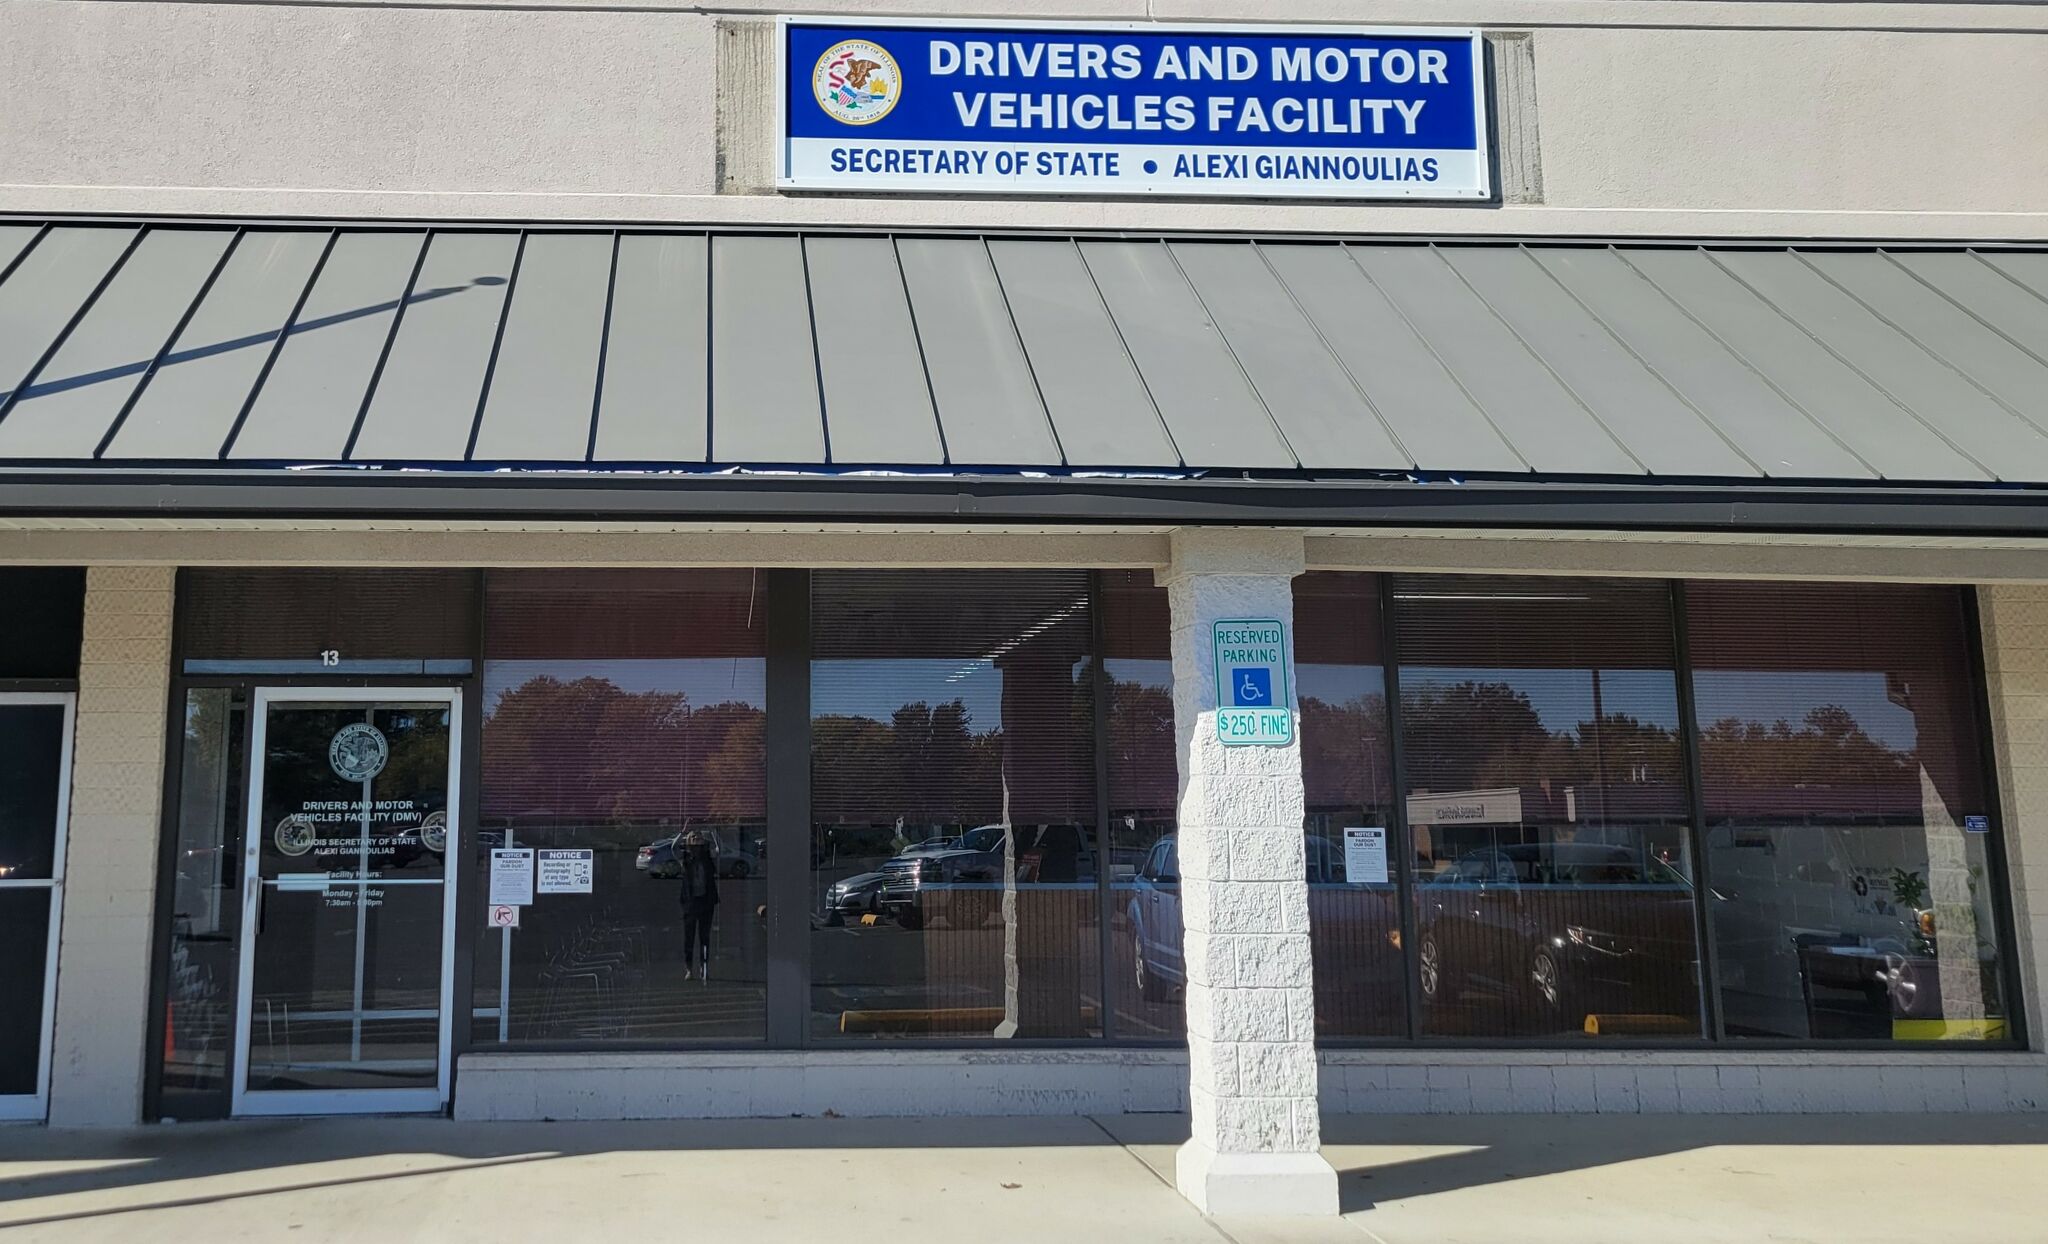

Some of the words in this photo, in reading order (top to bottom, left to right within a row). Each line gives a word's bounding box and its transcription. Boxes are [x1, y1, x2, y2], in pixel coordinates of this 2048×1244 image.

[930, 40, 1142, 79] DRIVERS
[1153, 45, 1259, 81] AND
[1271, 47, 1449, 84] MOTOR
[952, 91, 1196, 131] VEHICLES
[1208, 96, 1427, 134] FACILITY
[830, 147, 989, 175] SECRETARY
[995, 151, 1030, 175] OF
[1036, 151, 1120, 177] STATE
[1173, 153, 1249, 179] ALEXI
[1255, 154, 1439, 182] GIANNOULIAS
[1217, 630, 1280, 644] RESERVED
[320, 650, 339, 666] 13
[1223, 649, 1277, 663] PARKING
[1261, 715, 1288, 735] FINE
[303, 801, 348, 810] DRIVERS
[351, 801, 373, 810] AND
[375, 800, 414, 810] MOTOR
[290, 813, 342, 822] VEHICLES
[344, 813, 390, 822] FACILITY
[392, 812, 422, 823] (DMV)
[293, 838, 327, 846] ILLINOIS
[328, 838, 377, 846] SECRETARY
[378, 838, 390, 846] OF
[391, 838, 417, 846] STATE
[314, 848, 338, 856] ALEXI
[339, 847, 395, 855] GIANNOULIAS
[549, 851, 582, 859] NOTICE
[326, 870, 354, 878] Facility
[322, 889, 353, 898] Monday
[357, 899, 383, 908] 00pm
